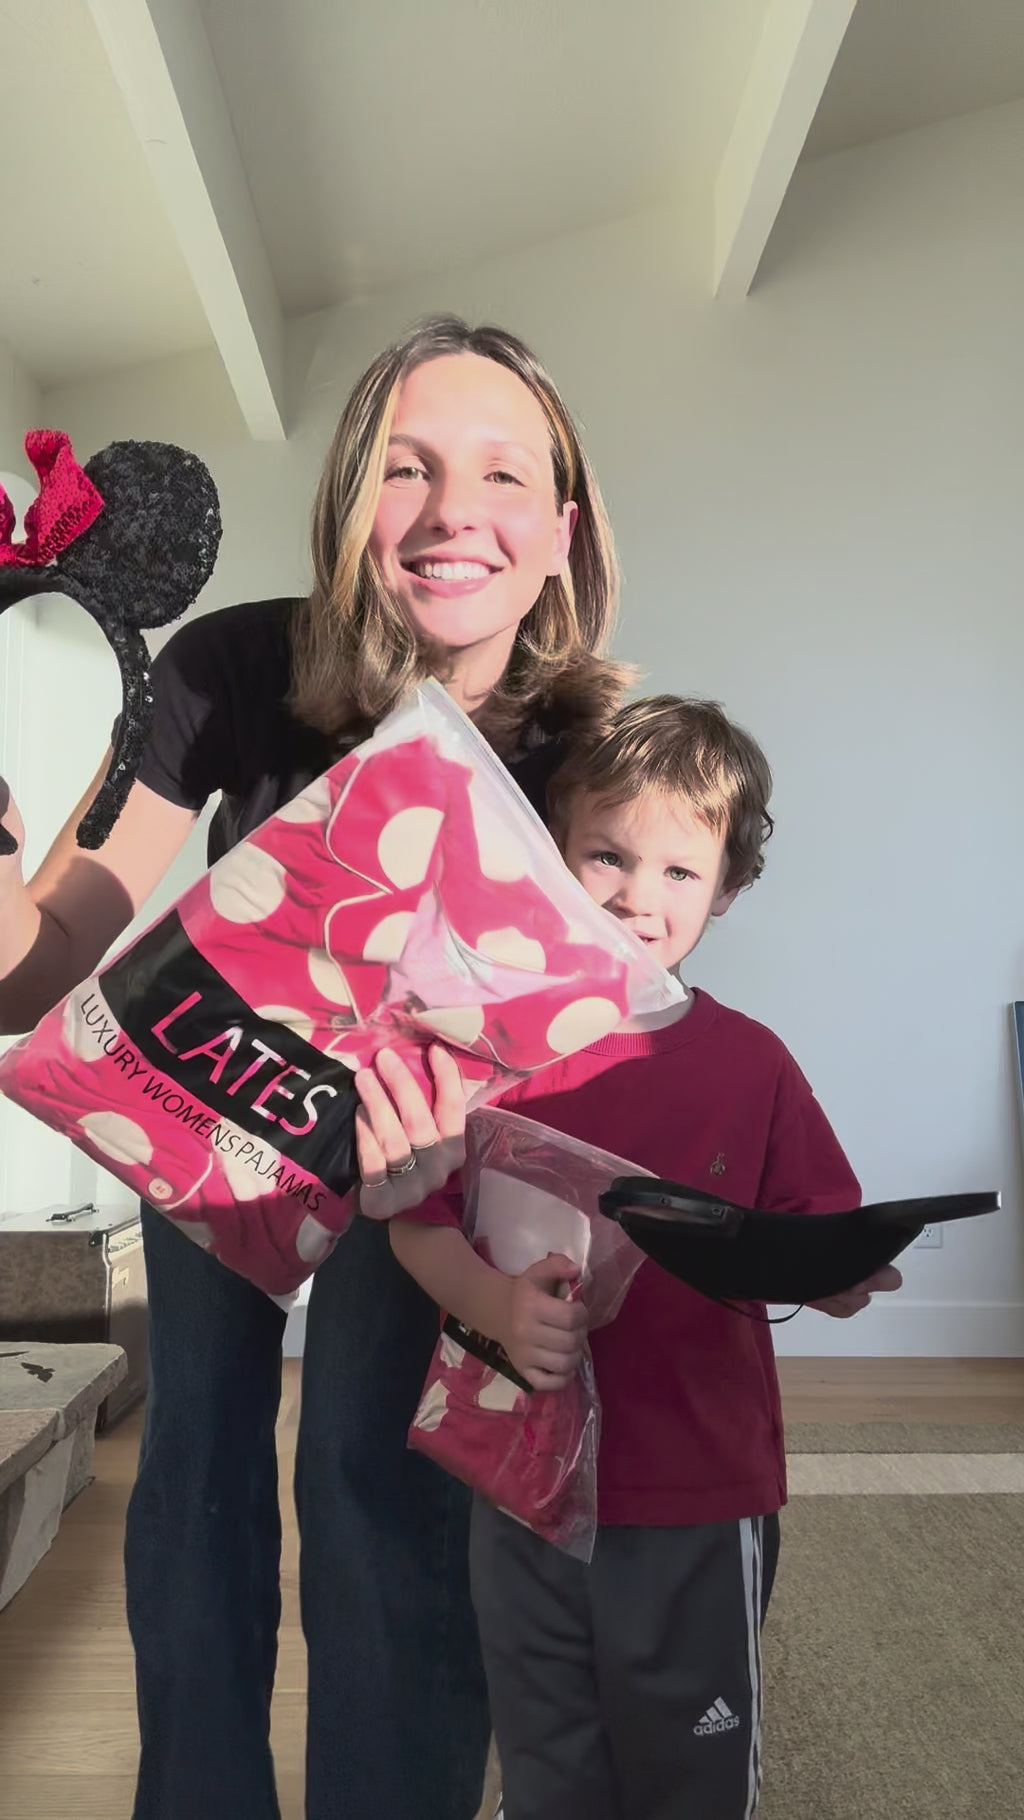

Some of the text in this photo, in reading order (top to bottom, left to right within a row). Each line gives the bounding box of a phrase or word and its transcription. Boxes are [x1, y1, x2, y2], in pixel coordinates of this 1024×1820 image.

[80, 993, 148, 1081] LUXURY
[151, 991, 338, 1136] LATES
[693, 1715, 740, 1736] adidas
